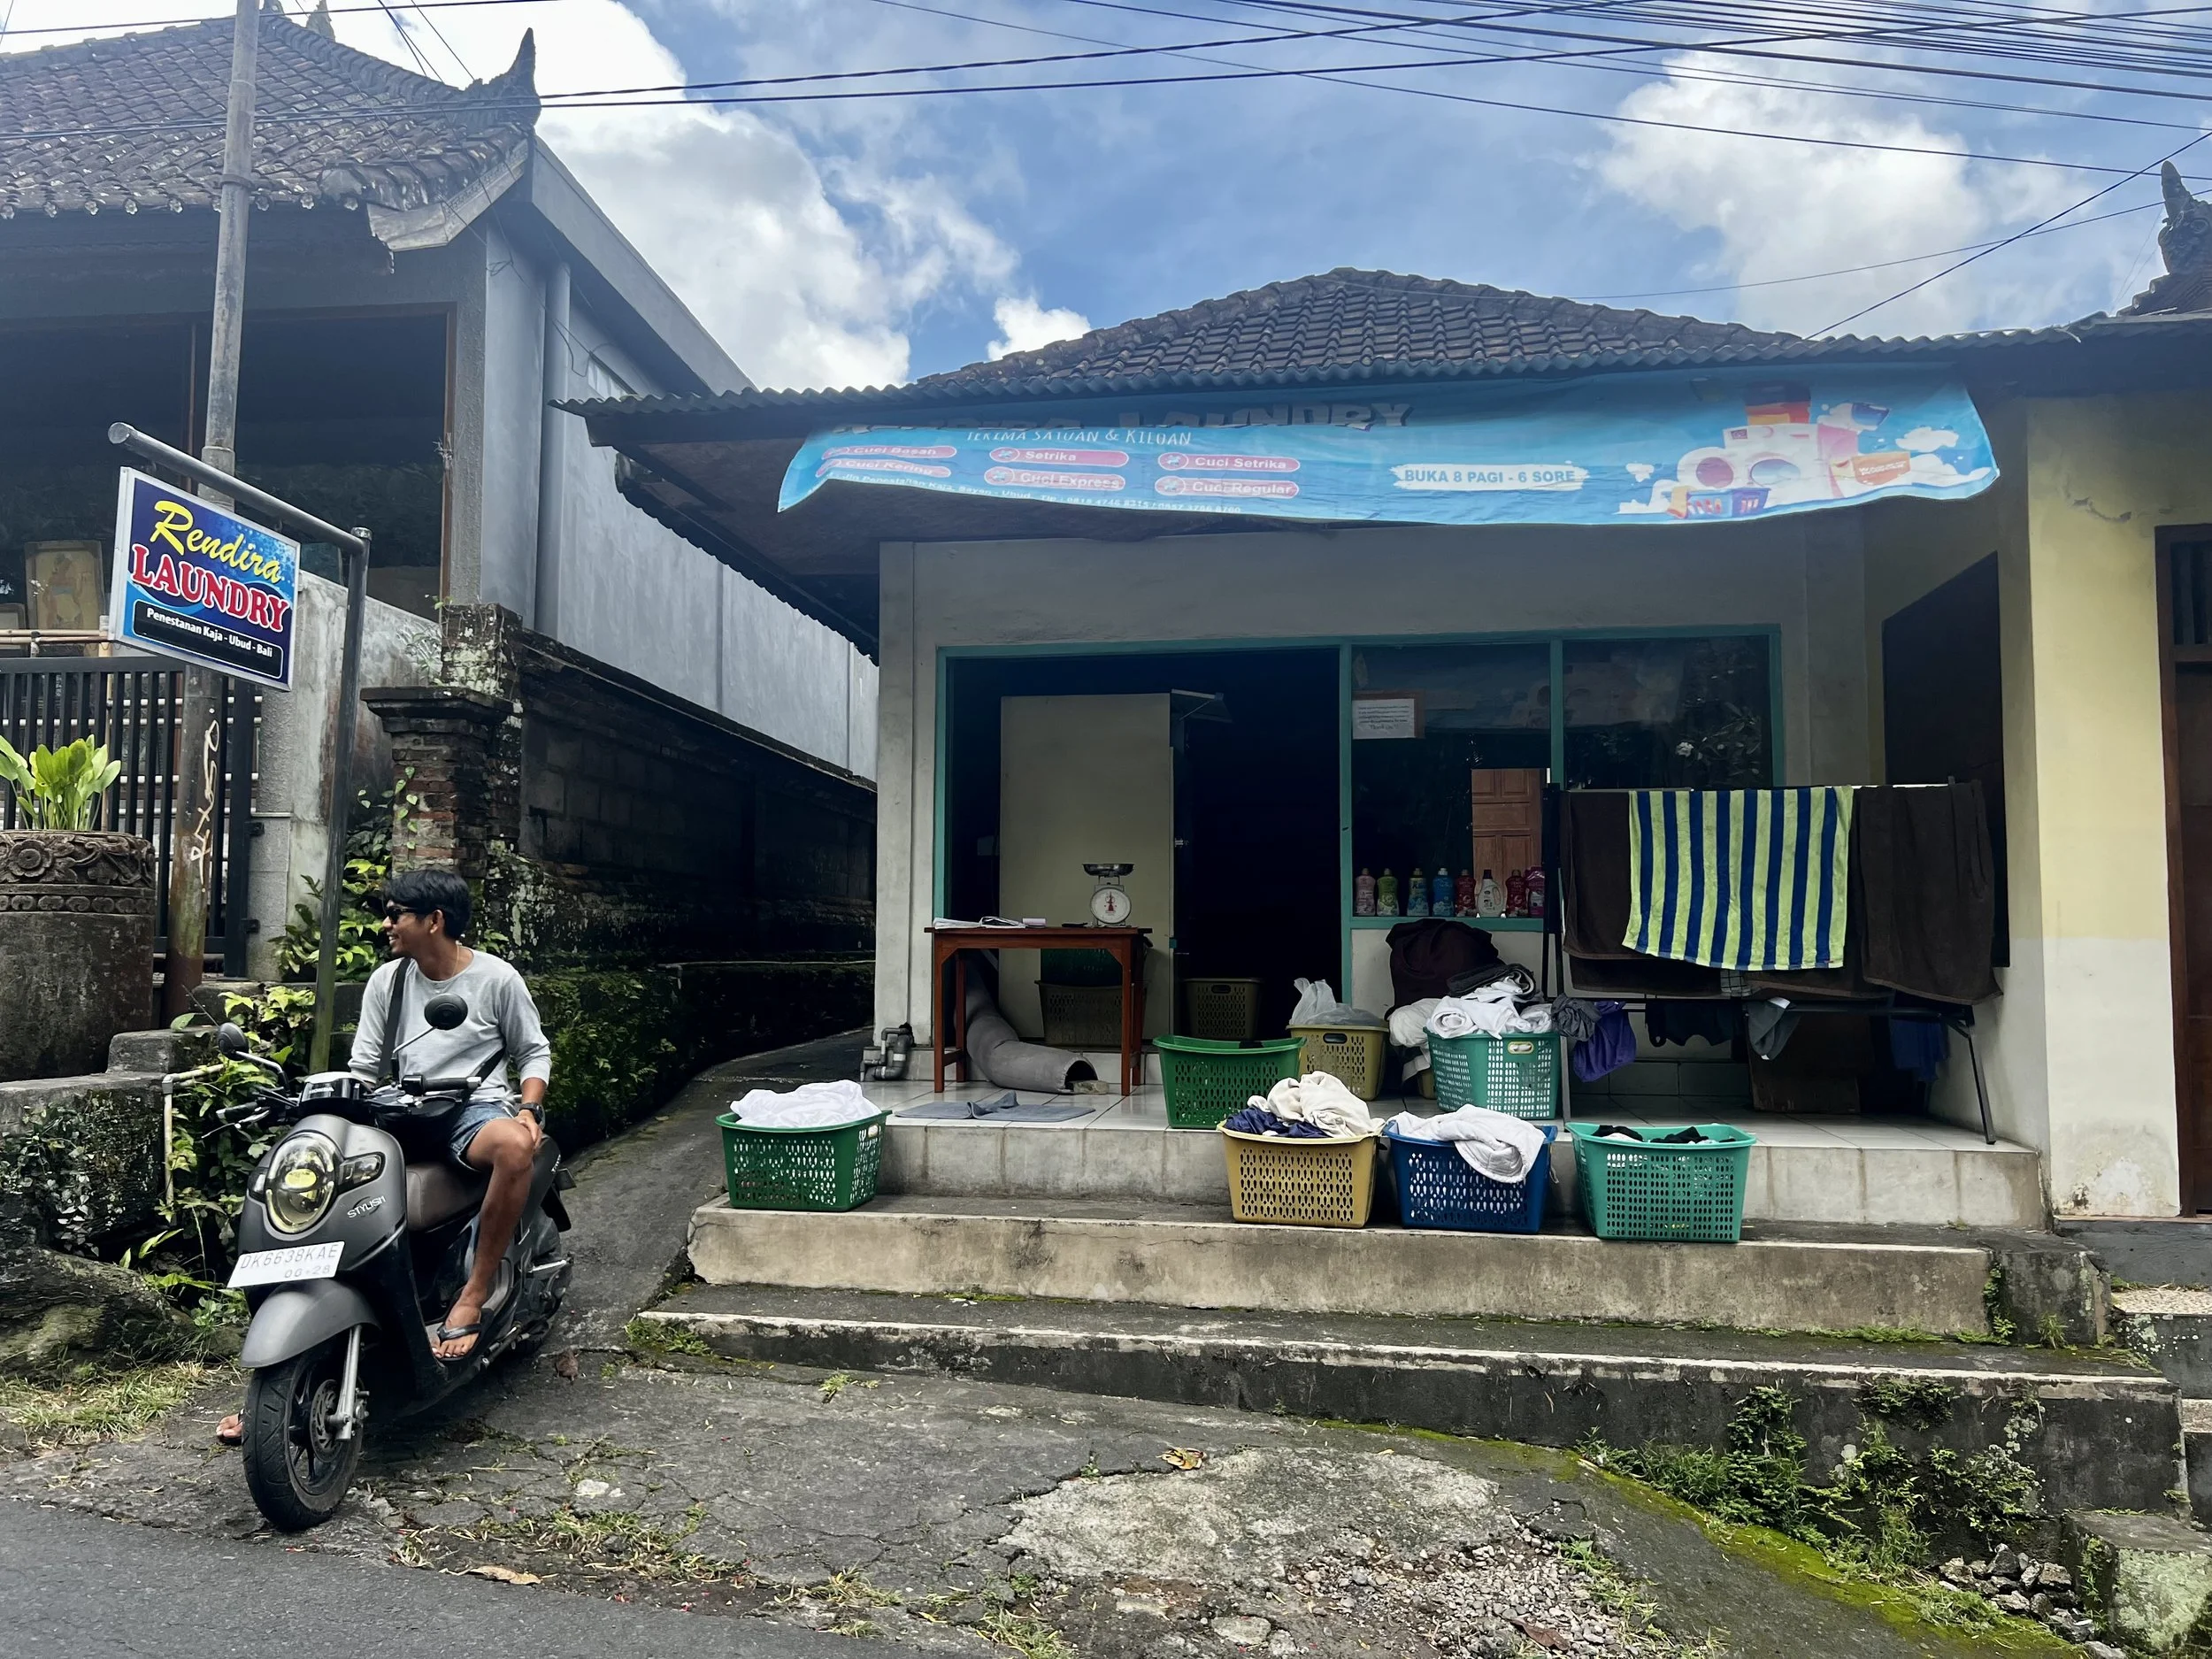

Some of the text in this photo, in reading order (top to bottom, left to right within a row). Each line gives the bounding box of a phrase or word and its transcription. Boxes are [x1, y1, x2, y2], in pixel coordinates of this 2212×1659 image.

[1105, 429, 1119, 441] &
[1025, 450, 1077, 461] Setrika
[1195, 457, 1287, 469] Cuci Setrika
[1059, 475, 1120, 489] Express
[1404, 469, 1448, 483] BUKA
[1454, 471, 1463, 483] 8
[1468, 471, 1503, 484] PAGI
[1517, 471, 1528, 483] 6
[1532, 470, 1575, 483] SORE
[1232, 482, 1293, 496] Regular
[150, 500, 282, 584] Rendira
[132, 543, 291, 633] LAUNDRY
[147, 607, 202, 634] Penestanan
[203, 626, 223, 642] Kaja
[228, 634, 251, 651] Ubud
[256, 643, 273, 658] Bali
[347, 1195, 386, 1218] STYLISH
